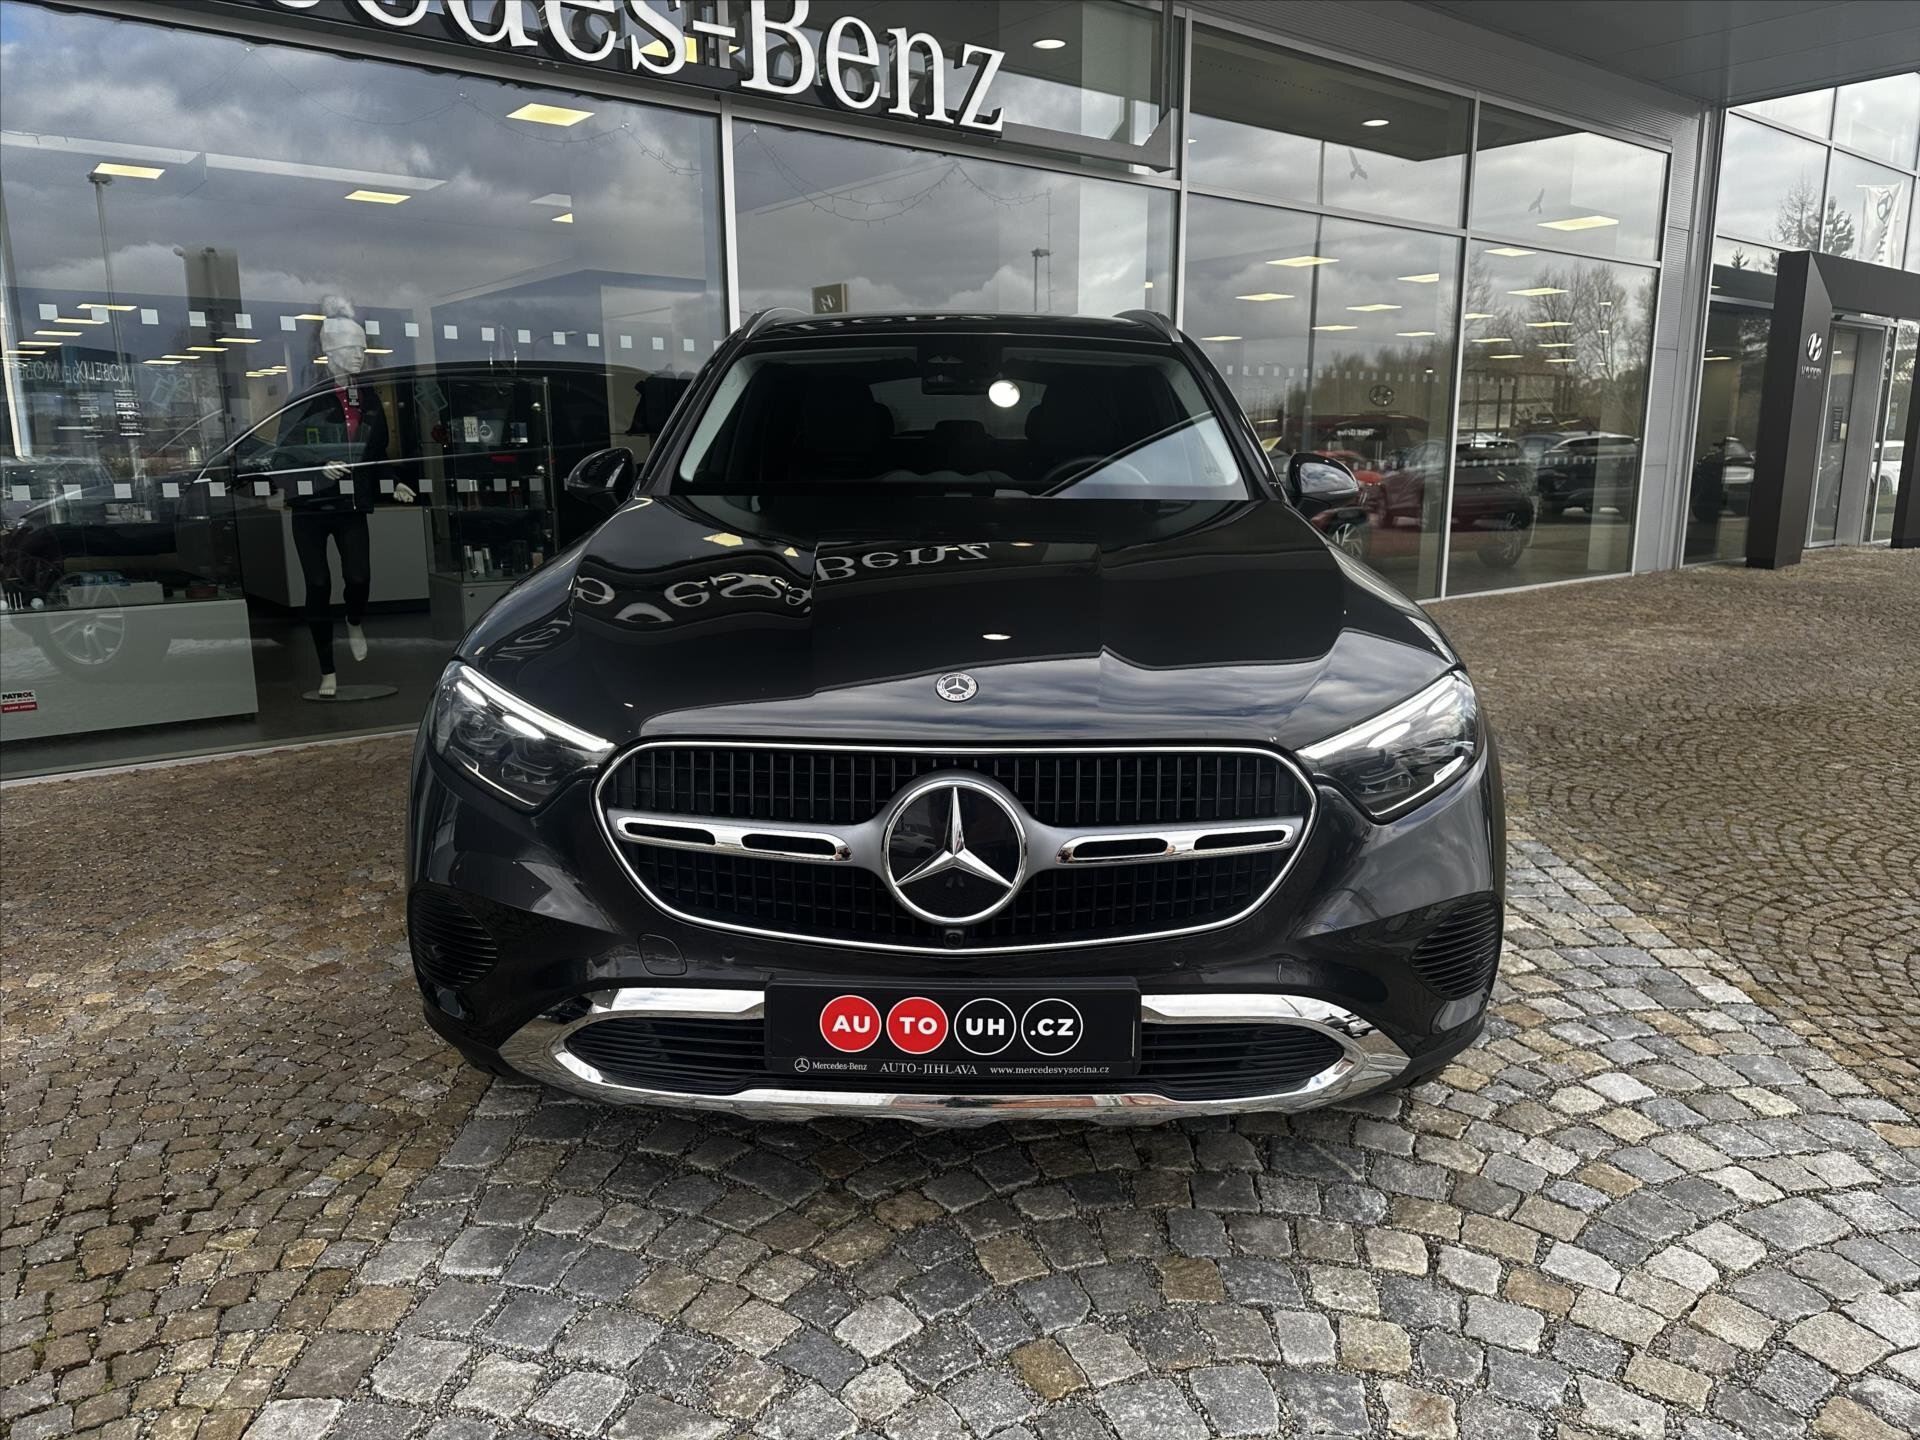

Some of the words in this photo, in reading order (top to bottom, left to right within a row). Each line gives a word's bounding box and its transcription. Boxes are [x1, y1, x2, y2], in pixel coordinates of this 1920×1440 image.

[832, 1015, 871, 1033] AU
[899, 1016, 938, 1035] TO
[965, 1018, 1005, 1036] UH
[1029, 1018, 1074, 1036] .CZ
[812, 1061, 868, 1071] Mercedes-Benz
[880, 1063, 978, 1075] AUTO-JIHLAVA
[990, 1065, 1110, 1075] www.mercedesvysocina.cz
